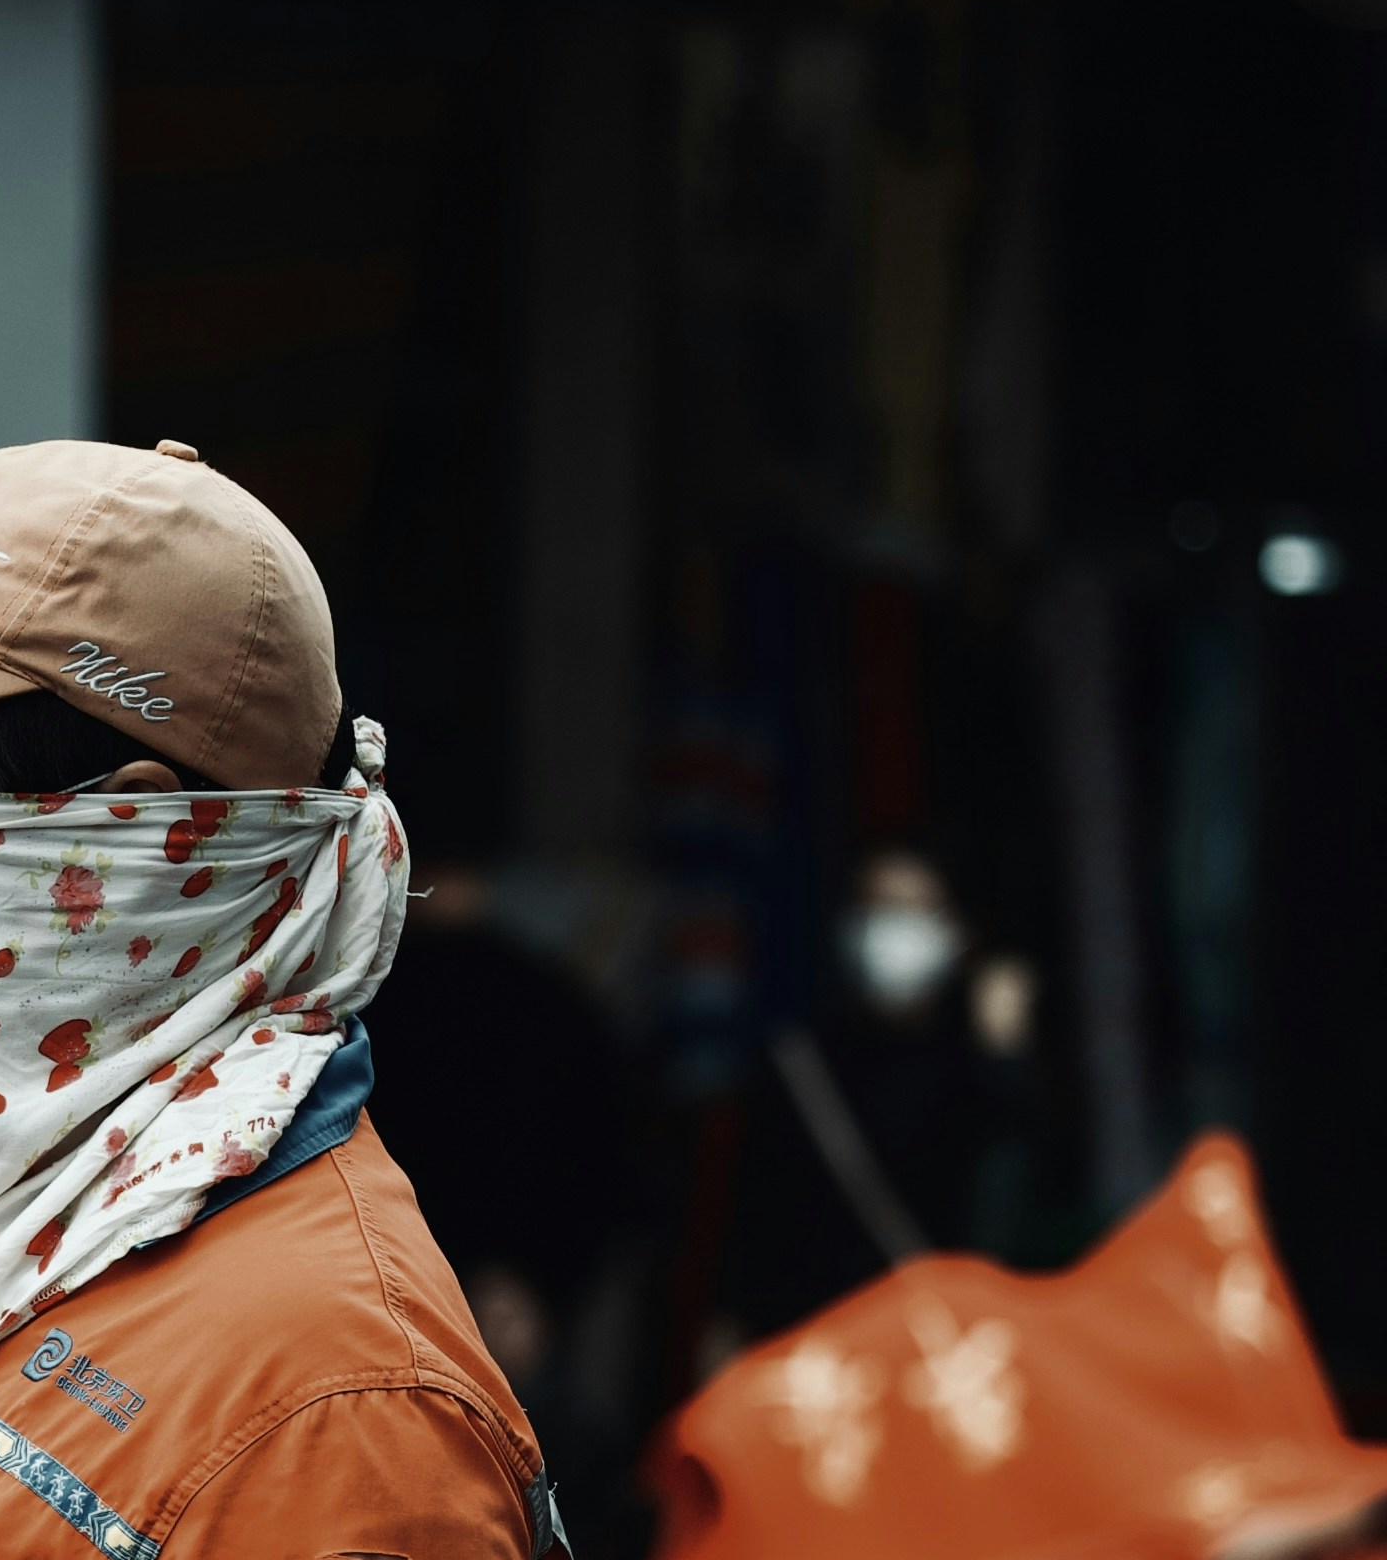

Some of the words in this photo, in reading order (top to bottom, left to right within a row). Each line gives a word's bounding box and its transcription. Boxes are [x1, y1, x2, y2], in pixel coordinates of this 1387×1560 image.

[59, 641, 175, 722] Nike
[55, 1375, 91, 1404] BEIJING
[65, 1354, 146, 1420] 北京环卫
